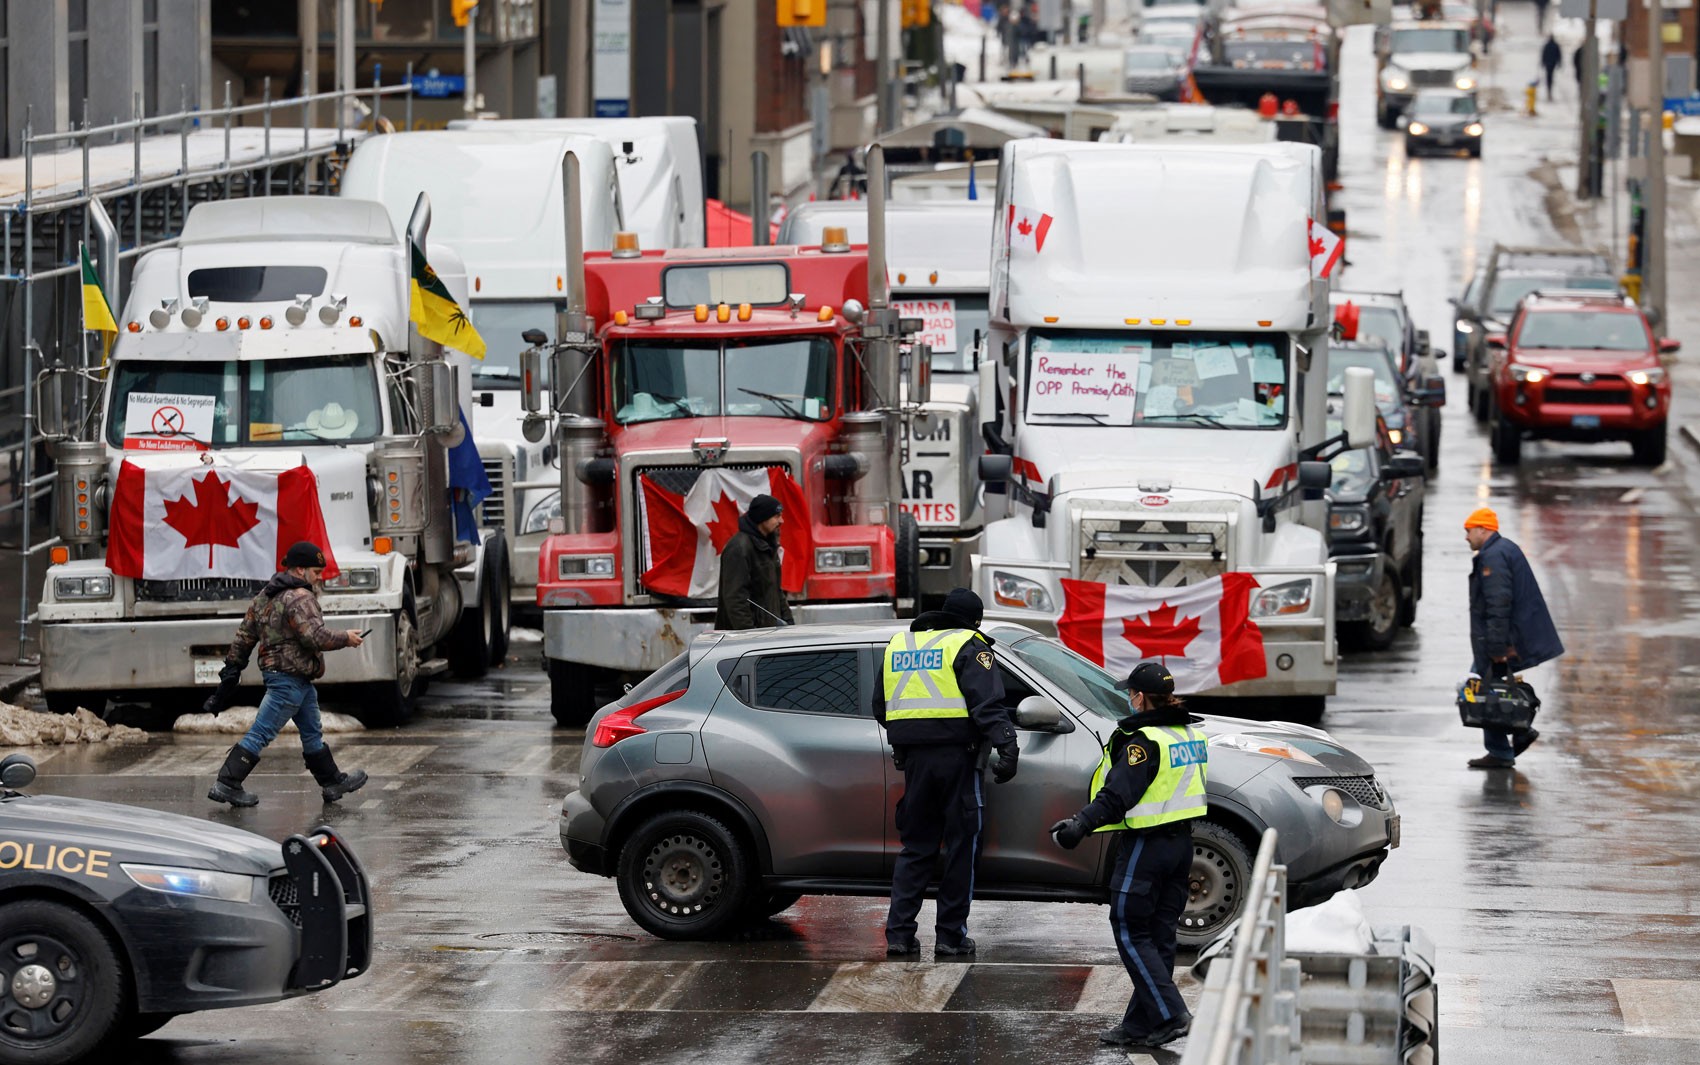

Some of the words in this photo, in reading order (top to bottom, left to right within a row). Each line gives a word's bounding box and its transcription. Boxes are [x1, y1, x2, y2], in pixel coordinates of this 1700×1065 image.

[887, 301, 951, 315] ANADA
[1038, 356, 1094, 376] Remember
[1105, 363, 1126, 379] the
[1036, 380, 1062, 395] OPP
[136, 395, 153, 404] Medical
[893, 651, 941, 670] POLICE
